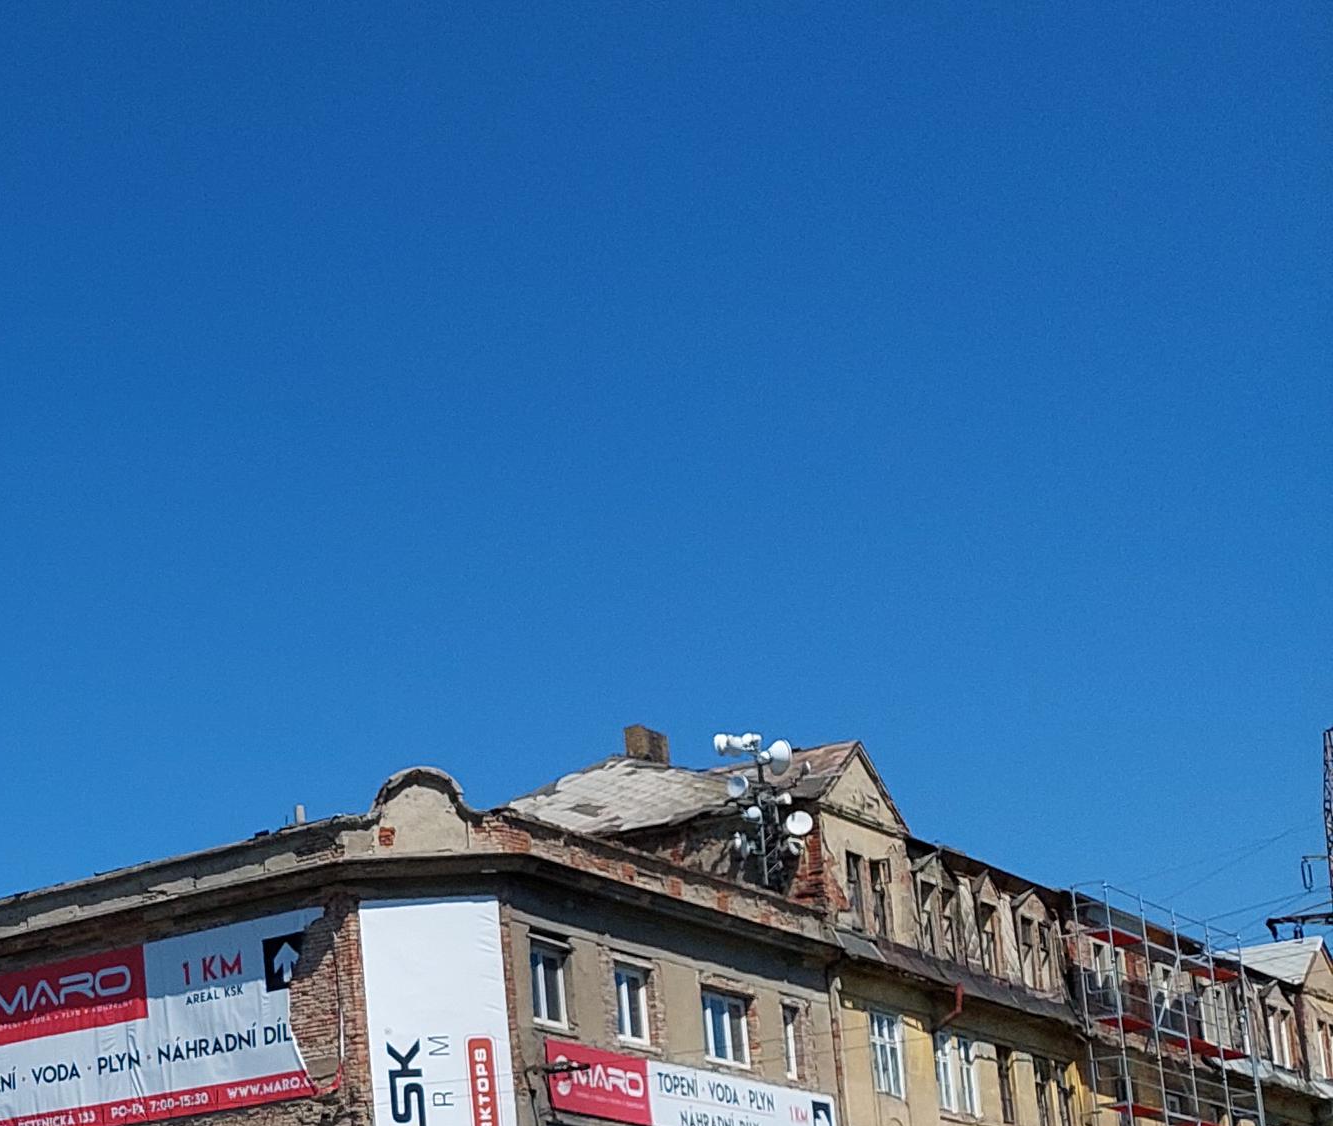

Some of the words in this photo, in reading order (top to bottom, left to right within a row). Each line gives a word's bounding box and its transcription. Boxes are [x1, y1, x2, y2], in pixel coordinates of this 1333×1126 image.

[183, 961, 190, 986] 1
[202, 950, 242, 982] KM
[186, 988, 220, 1005] AREAL
[224, 984, 244, 998] KSK
[32, 1061, 81, 1085] VODA
[98, 1051, 141, 1075] PLYN
[158, 1022, 256, 1065] NÁHRADNÍ
[574, 1064, 644, 1097] MARO
[657, 1072, 699, 1098] TOPENÍ
[707, 1080, 739, 1105] VODA
[749, 1088, 774, 1111] PLYN
[78, 1110, 96, 1124] 133
